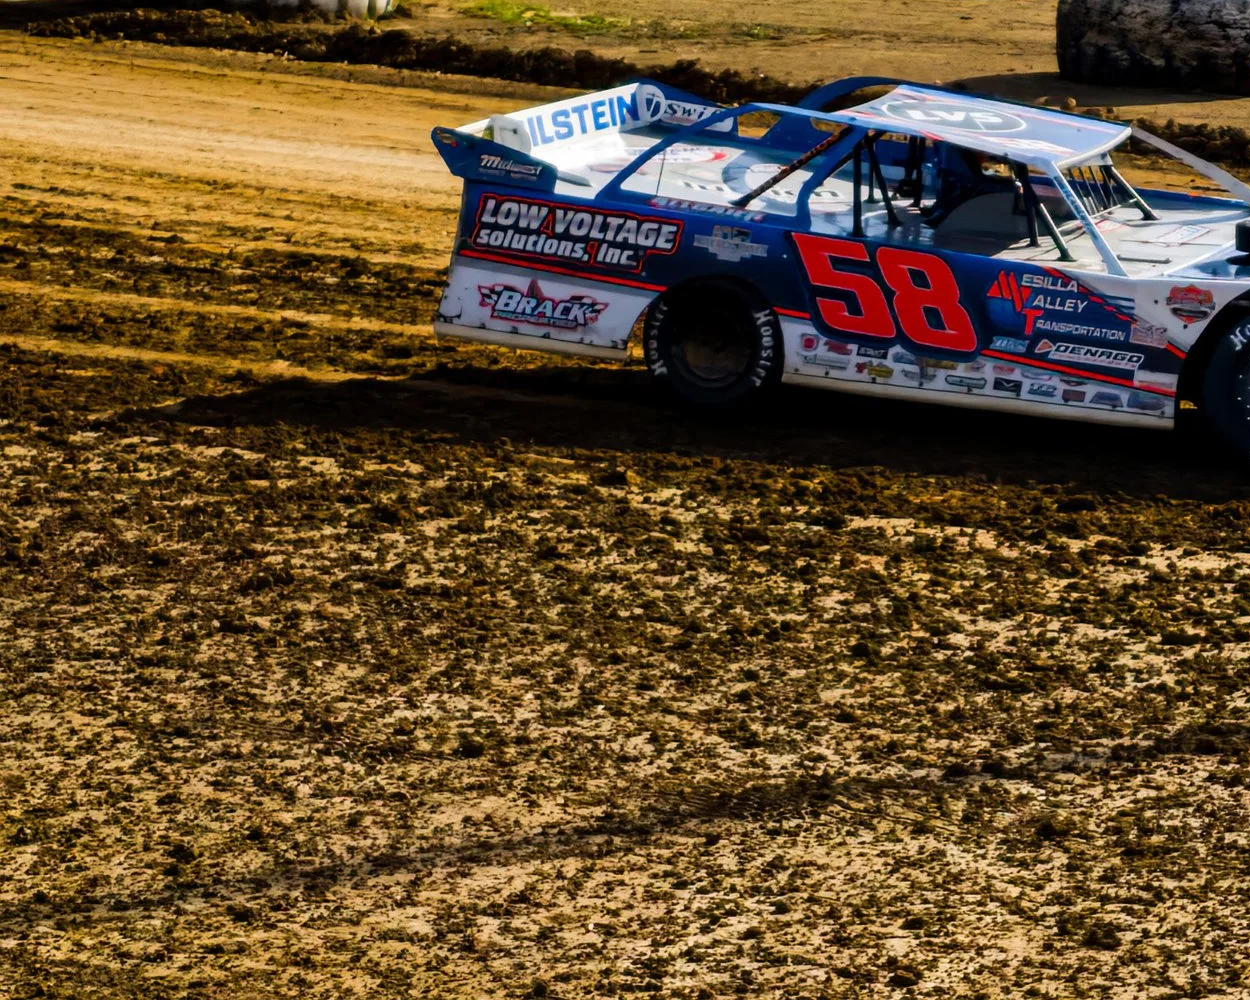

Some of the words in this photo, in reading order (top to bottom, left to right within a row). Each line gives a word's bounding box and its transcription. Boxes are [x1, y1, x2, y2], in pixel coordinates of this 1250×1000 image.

[527, 91, 640, 147] ILSTEIN
[481, 199, 549, 230] LOW
[552, 208, 678, 250] VOLTAGE
[495, 289, 591, 325] BRACK
[792, 232, 978, 353] 58
[751, 309, 774, 387] Hoosier
[1054, 344, 1143, 363] DENAGO
